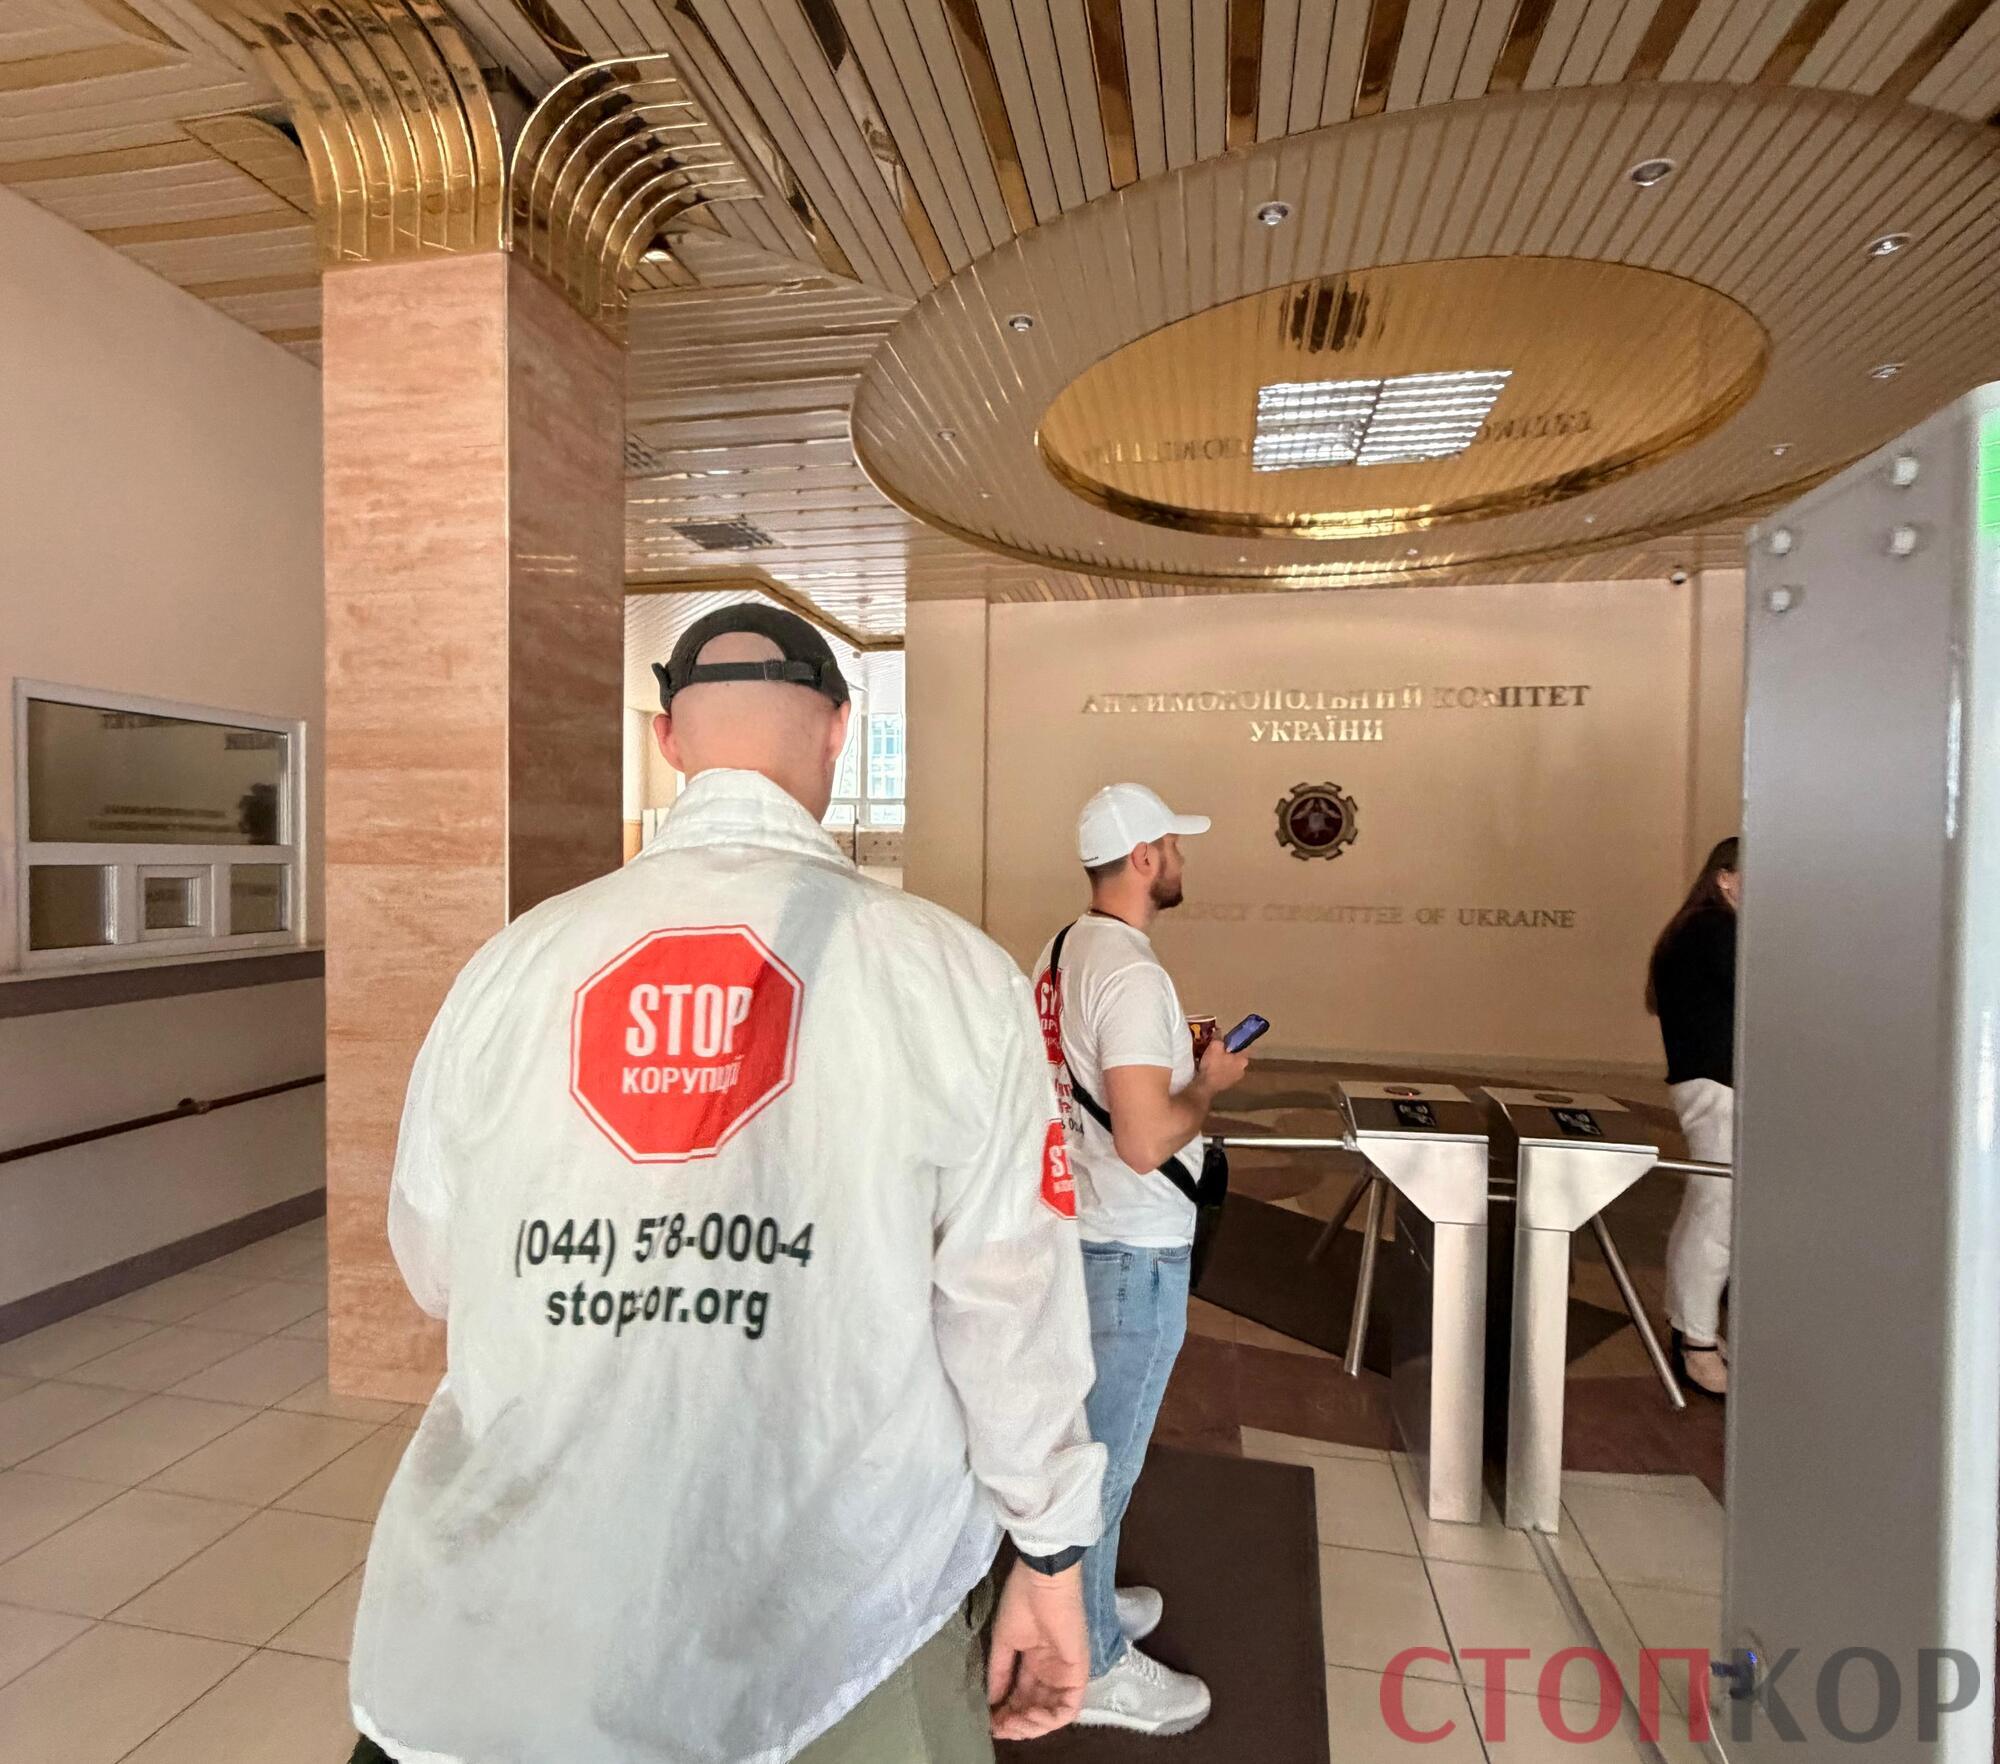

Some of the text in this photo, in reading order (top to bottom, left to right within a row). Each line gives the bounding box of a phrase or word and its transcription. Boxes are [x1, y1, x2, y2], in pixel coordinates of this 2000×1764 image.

[1249, 715, 1384, 742] УКРАЇНИ
[1415, 907, 1446, 925] OF
[1457, 907, 1577, 928] UKRAINE
[625, 983, 753, 1058] STOP
[514, 1212, 815, 1277] (044) 58-000-4
[545, 1280, 769, 1340] stopor.org
